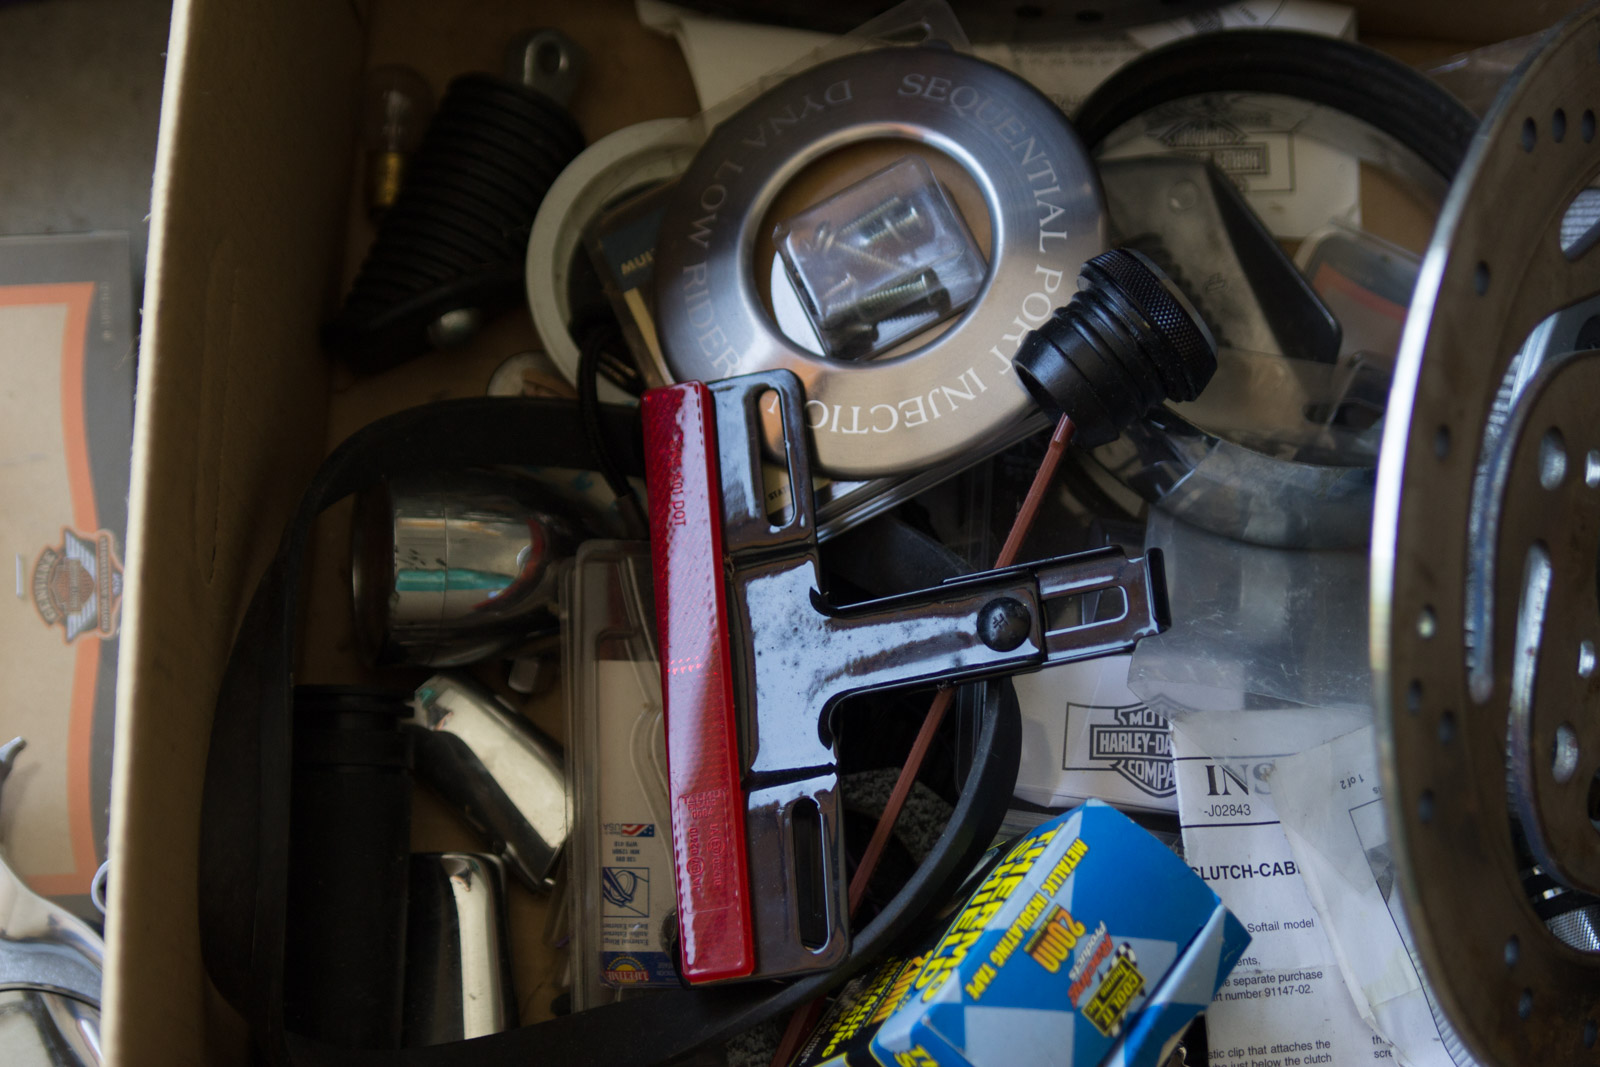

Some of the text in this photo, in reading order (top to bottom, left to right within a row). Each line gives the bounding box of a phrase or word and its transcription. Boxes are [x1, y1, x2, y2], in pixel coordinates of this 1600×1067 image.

[682, 79, 854, 378] DYNA LOW RIDER
[897, 73, 1068, 253] SEQUENTIAL
[990, 263, 1064, 375] PORT
[672, 500, 686, 527] DOT
[1129, 706, 1170, 727] MOT
[1099, 732, 1173, 755] HARLEY-DA
[1128, 760, 1176, 789] COMPA
[1205, 759, 1277, 796] INS
[1339, 780, 1347, 790] 2
[1347, 776, 1356, 788] of
[1204, 804, 1251, 817] -J02843
[1040, 838, 1089, 898] METALLIC
[1191, 860, 1301, 881] LUTCH-CAB
[915, 837, 1037, 989] SHIELD
[922, 822, 1065, 1003] THERMO
[1247, 918, 1315, 933] Softail model
[989, 892, 1049, 967] INSULATING
[1031, 908, 1086, 973] 2000
[1068, 920, 1107, 981] Products
[606, 970, 648, 982] LIFETIME
[965, 963, 997, 1001] TAPE
[1068, 933, 1114, 1011] Racing
[1100, 962, 1131, 997] Thermo
[1233, 975, 1276, 987] separate
[1278, 970, 1323, 984] purchase
[841, 960, 903, 1041] METALLIC
[1113, 973, 1140, 1010] COOL
[1225, 989, 1263, 1000] number
[1264, 984, 1314, 997] 91147-02.
[1208, 1040, 1331, 1060] stic clip that attaches the
[1372, 1035, 1385, 1045] th
[1251, 1056, 1281, 1067] below
[1285, 1055, 1301, 1066] the
[1303, 1053, 1332, 1064] clutch
